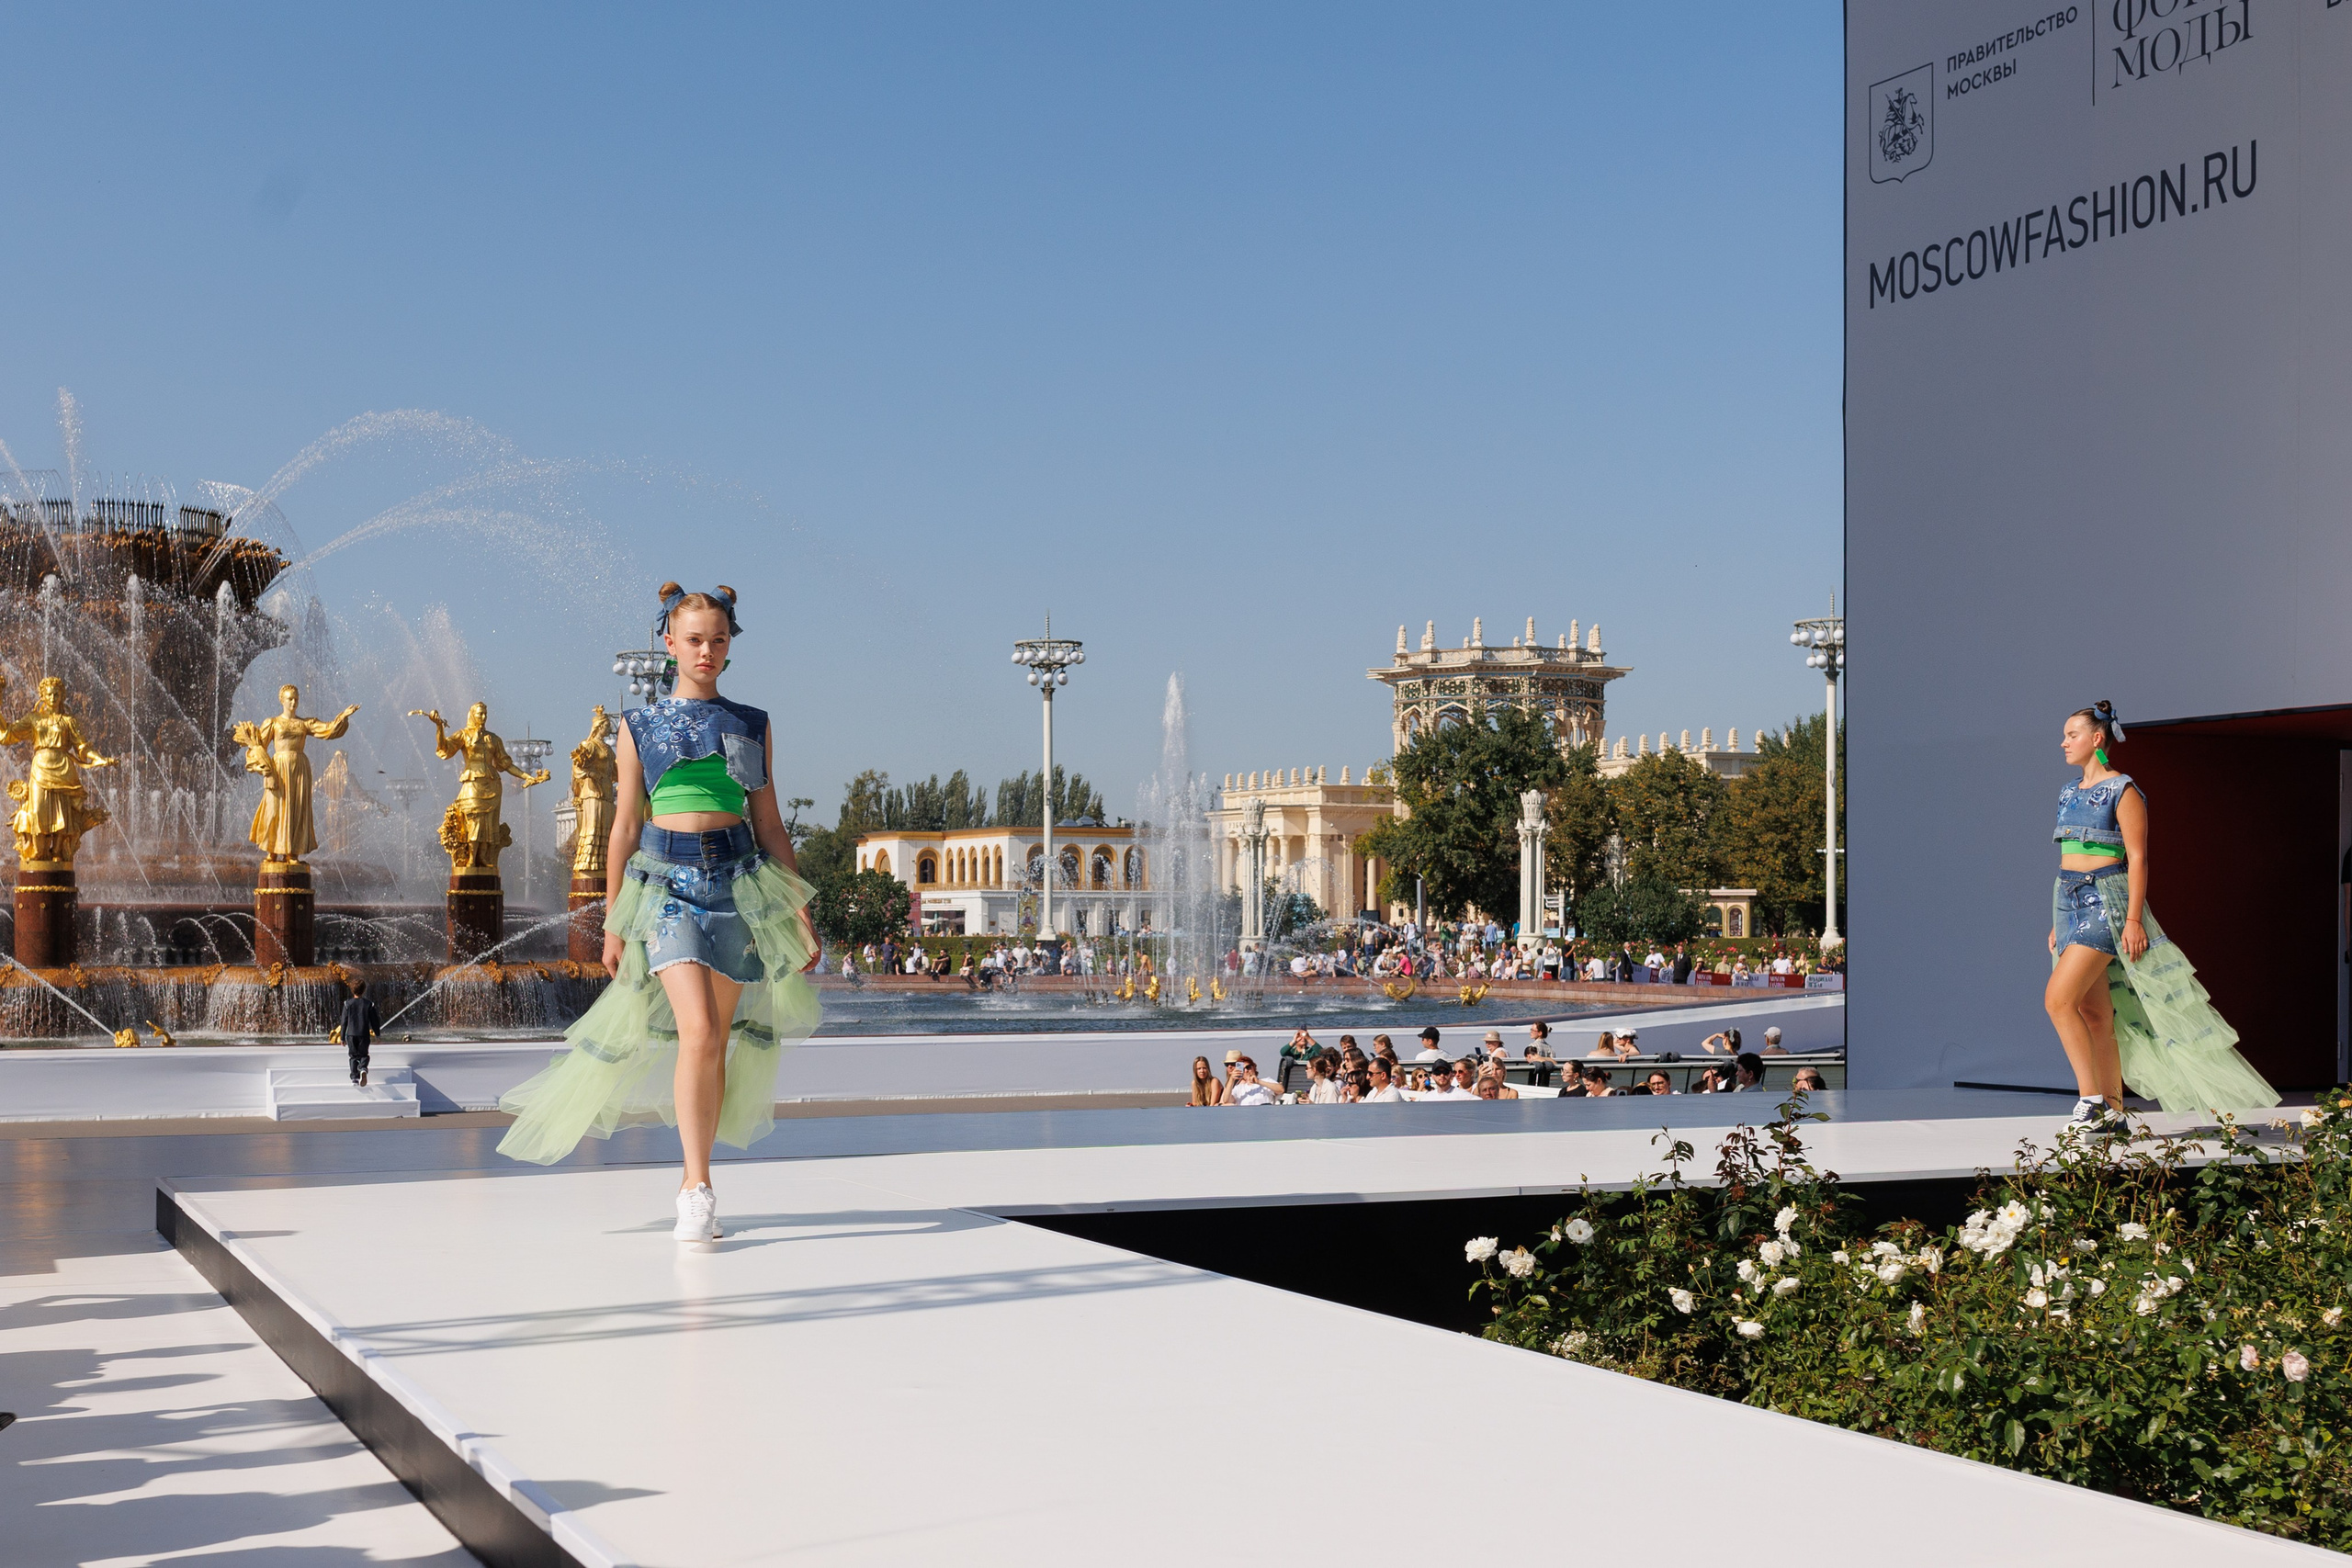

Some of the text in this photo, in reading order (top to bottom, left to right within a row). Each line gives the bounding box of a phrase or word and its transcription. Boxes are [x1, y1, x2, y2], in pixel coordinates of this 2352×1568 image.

[1947, 6, 2078, 73] ПРАВИТЕЛЬСТВО
[2111, 0, 2254, 89] МОДЫ
[1947, 58, 2017, 100] МОСКВЫ
[1869, 139, 2256, 310] MOSCOWFASHION.RU
